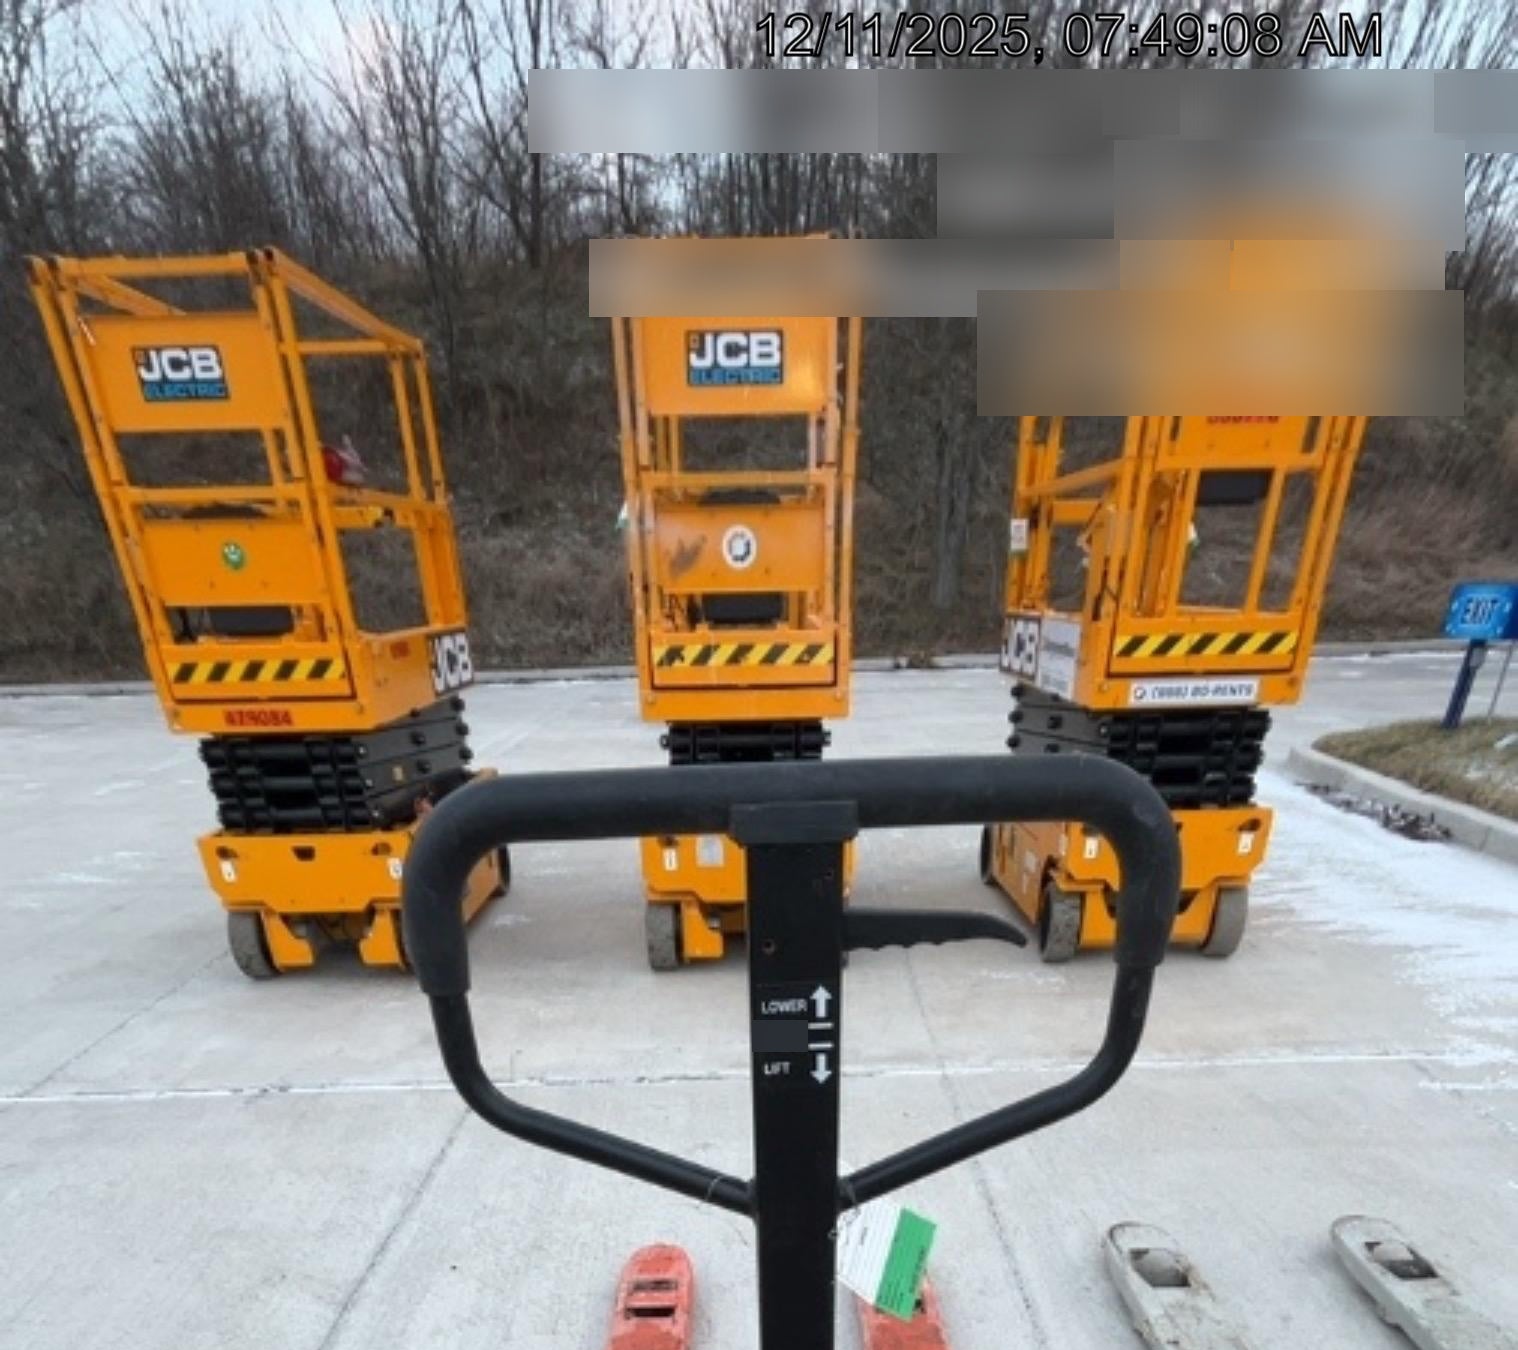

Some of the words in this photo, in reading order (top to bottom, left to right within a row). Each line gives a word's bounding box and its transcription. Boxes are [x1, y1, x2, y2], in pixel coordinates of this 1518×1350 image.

[137, 347, 223, 381] JCB
[688, 331, 781, 367] JCB
[1463, 596, 1502, 625] EXIT
[432, 632, 473, 691] JCB
[761, 998, 808, 1014] LOWER
[763, 1061, 791, 1076] LIFT
